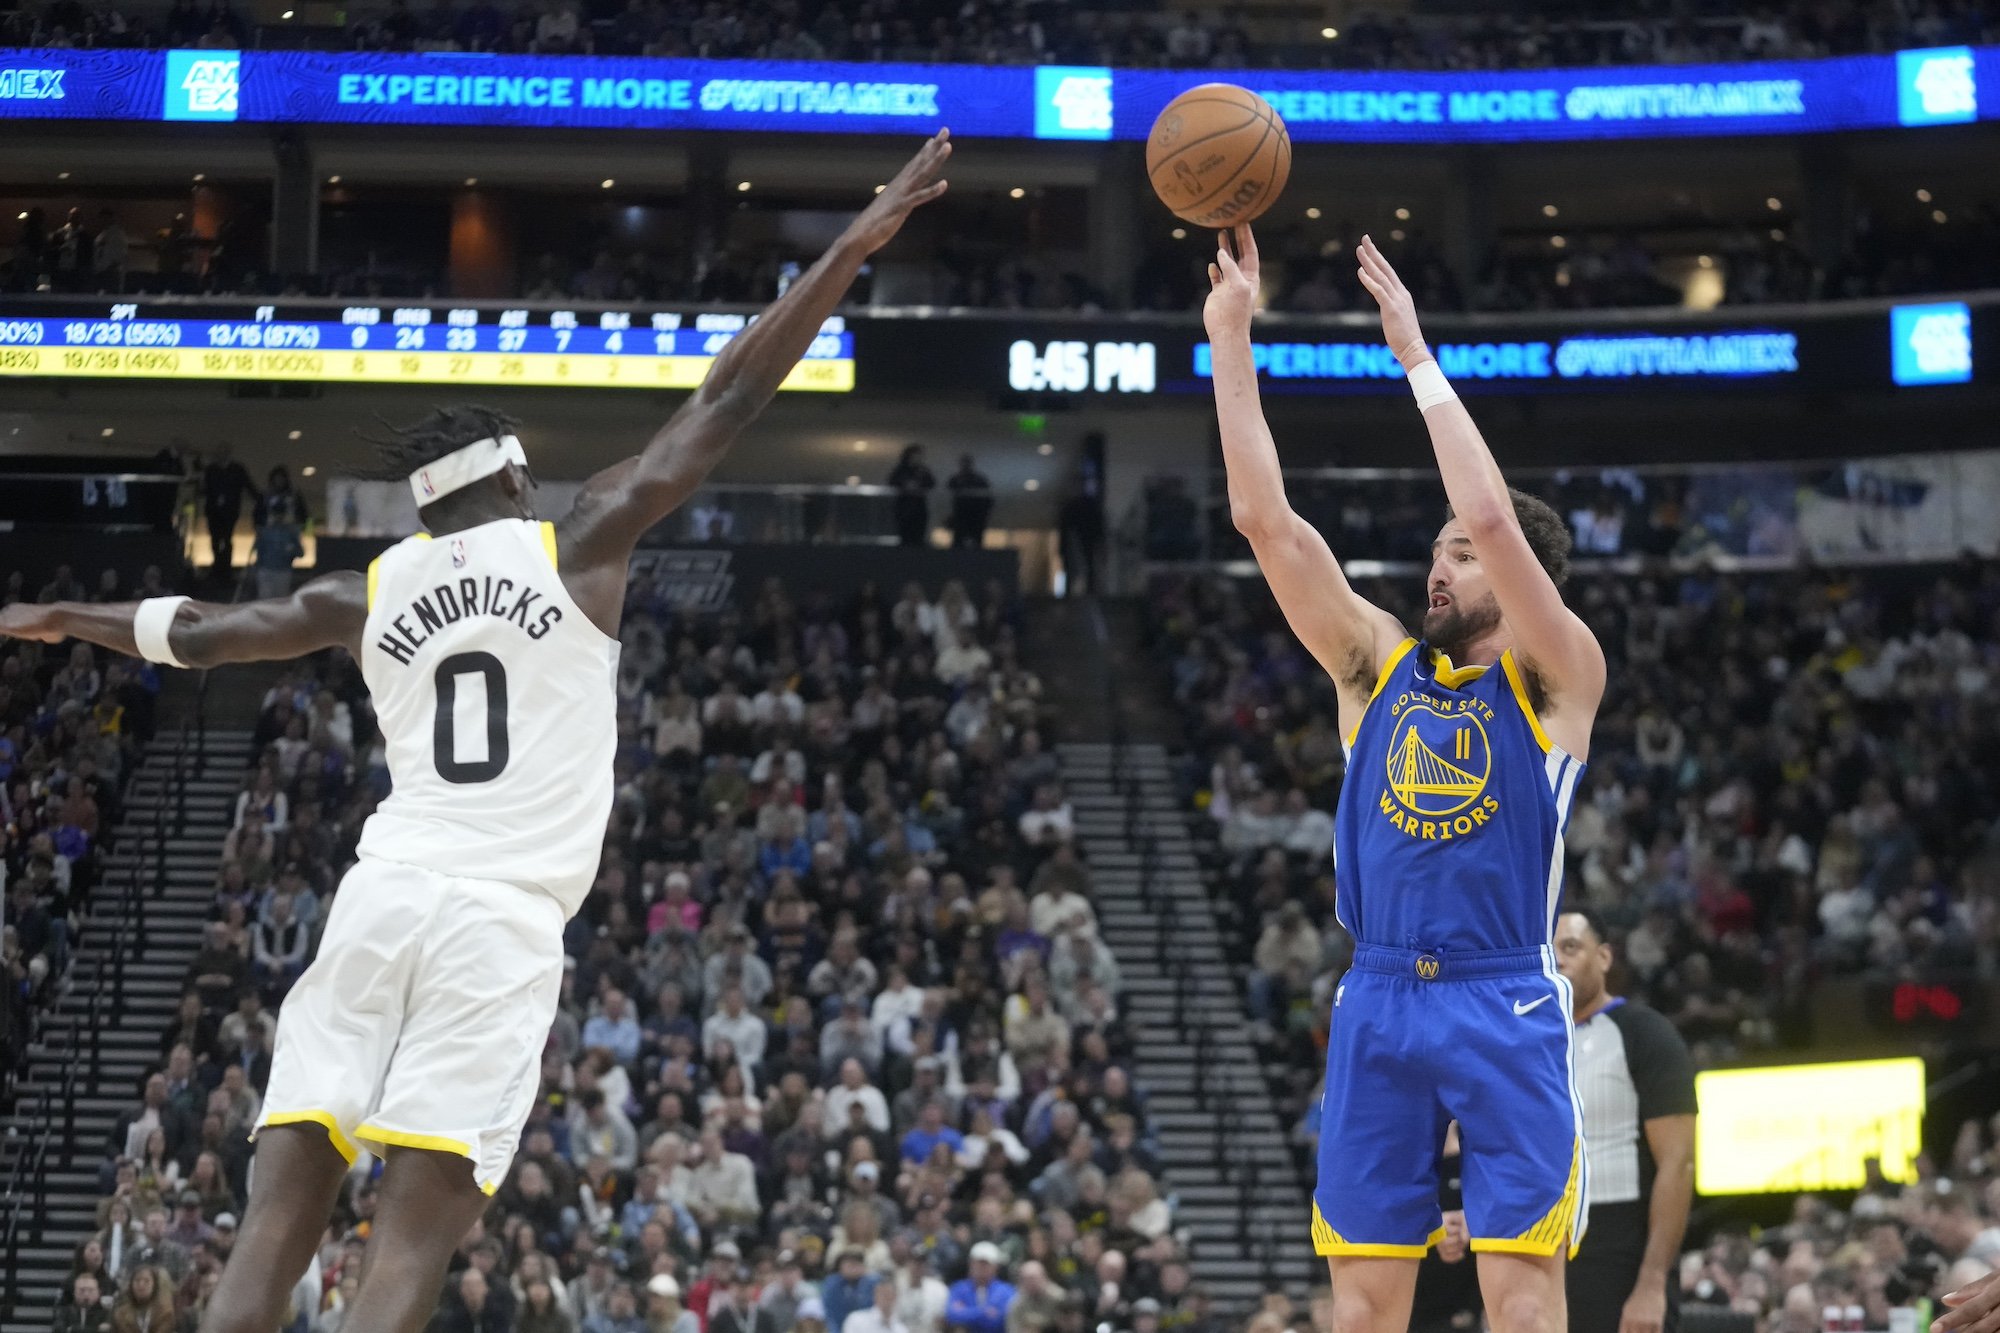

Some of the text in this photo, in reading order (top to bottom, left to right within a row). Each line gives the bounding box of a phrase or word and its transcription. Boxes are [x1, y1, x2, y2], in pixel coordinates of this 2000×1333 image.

[338, 74, 939, 115] EXPERIENCE MORE @WITHAMEX
[1258, 91, 1443, 122] PERIENCE
[1450, 90, 1560, 121] MORE
[207, 323, 262, 346] 13/15
[395, 327, 426, 350] 24
[555, 330, 572, 352] 7
[604, 331, 623, 354] 4
[1009, 340, 1156, 392] 8:45 PM
[1438, 343, 1550, 378] MORE
[377, 576, 562, 666] HENDRICKS
[433, 651, 509, 783] 0
[1391, 691, 1494, 721] GOLDEN STATE
[1455, 728, 1471, 760] 11
[1379, 789, 1499, 840] WARRIORS
[1417, 960, 1438, 977] W
